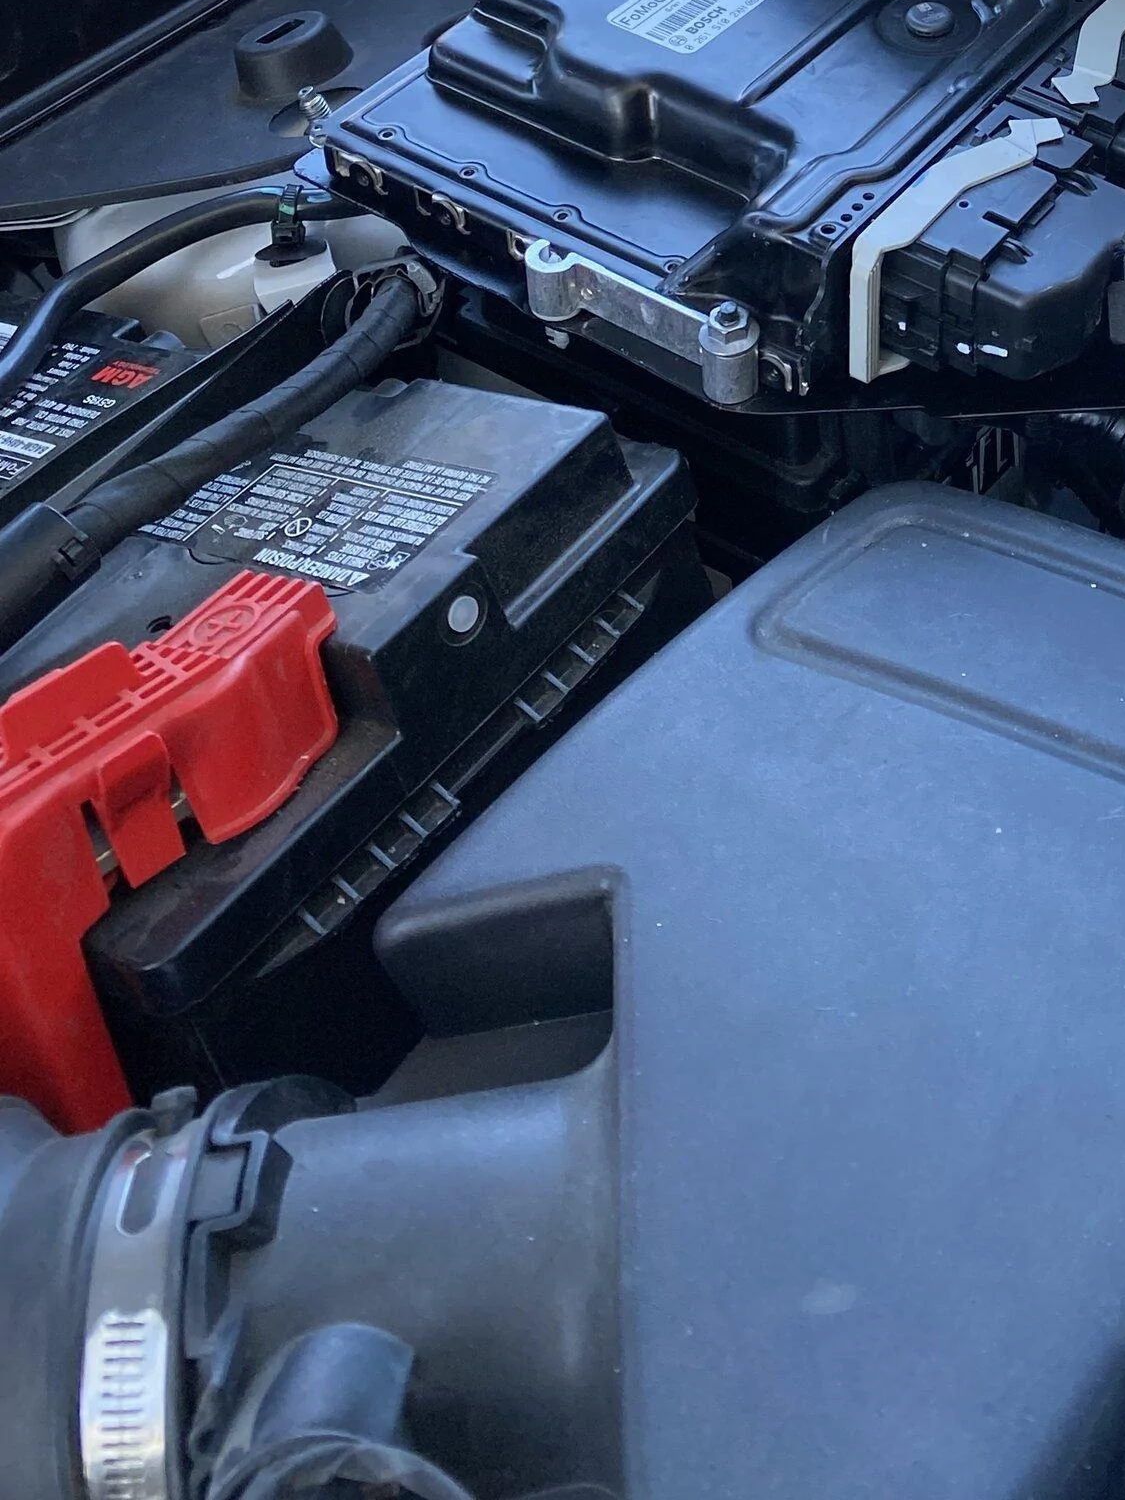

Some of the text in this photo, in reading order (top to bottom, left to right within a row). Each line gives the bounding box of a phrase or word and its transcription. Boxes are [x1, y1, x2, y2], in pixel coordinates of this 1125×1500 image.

[685, 6, 727, 34] BOSCH
[93, 367, 151, 388] AGM
[339, 543, 379, 559] EXPLOSIVE
[254, 549, 352, 581] DANGER/POISON
